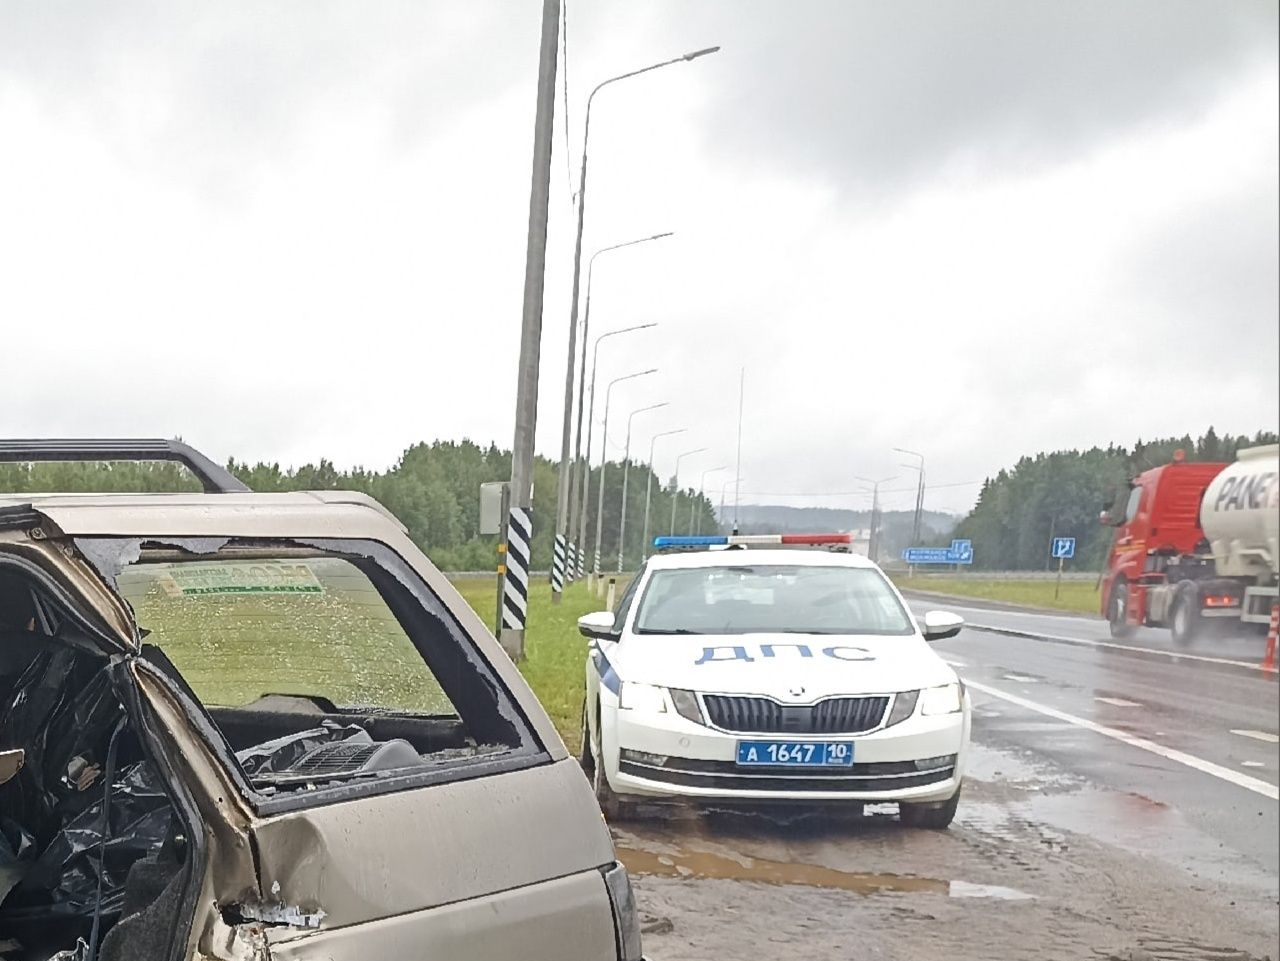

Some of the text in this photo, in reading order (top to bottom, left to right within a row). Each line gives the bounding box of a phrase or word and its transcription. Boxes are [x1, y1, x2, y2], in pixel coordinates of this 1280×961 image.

[694, 644, 876, 665] ДПС
[767, 744, 815, 762] 1647
[827, 744, 847, 758] 10
